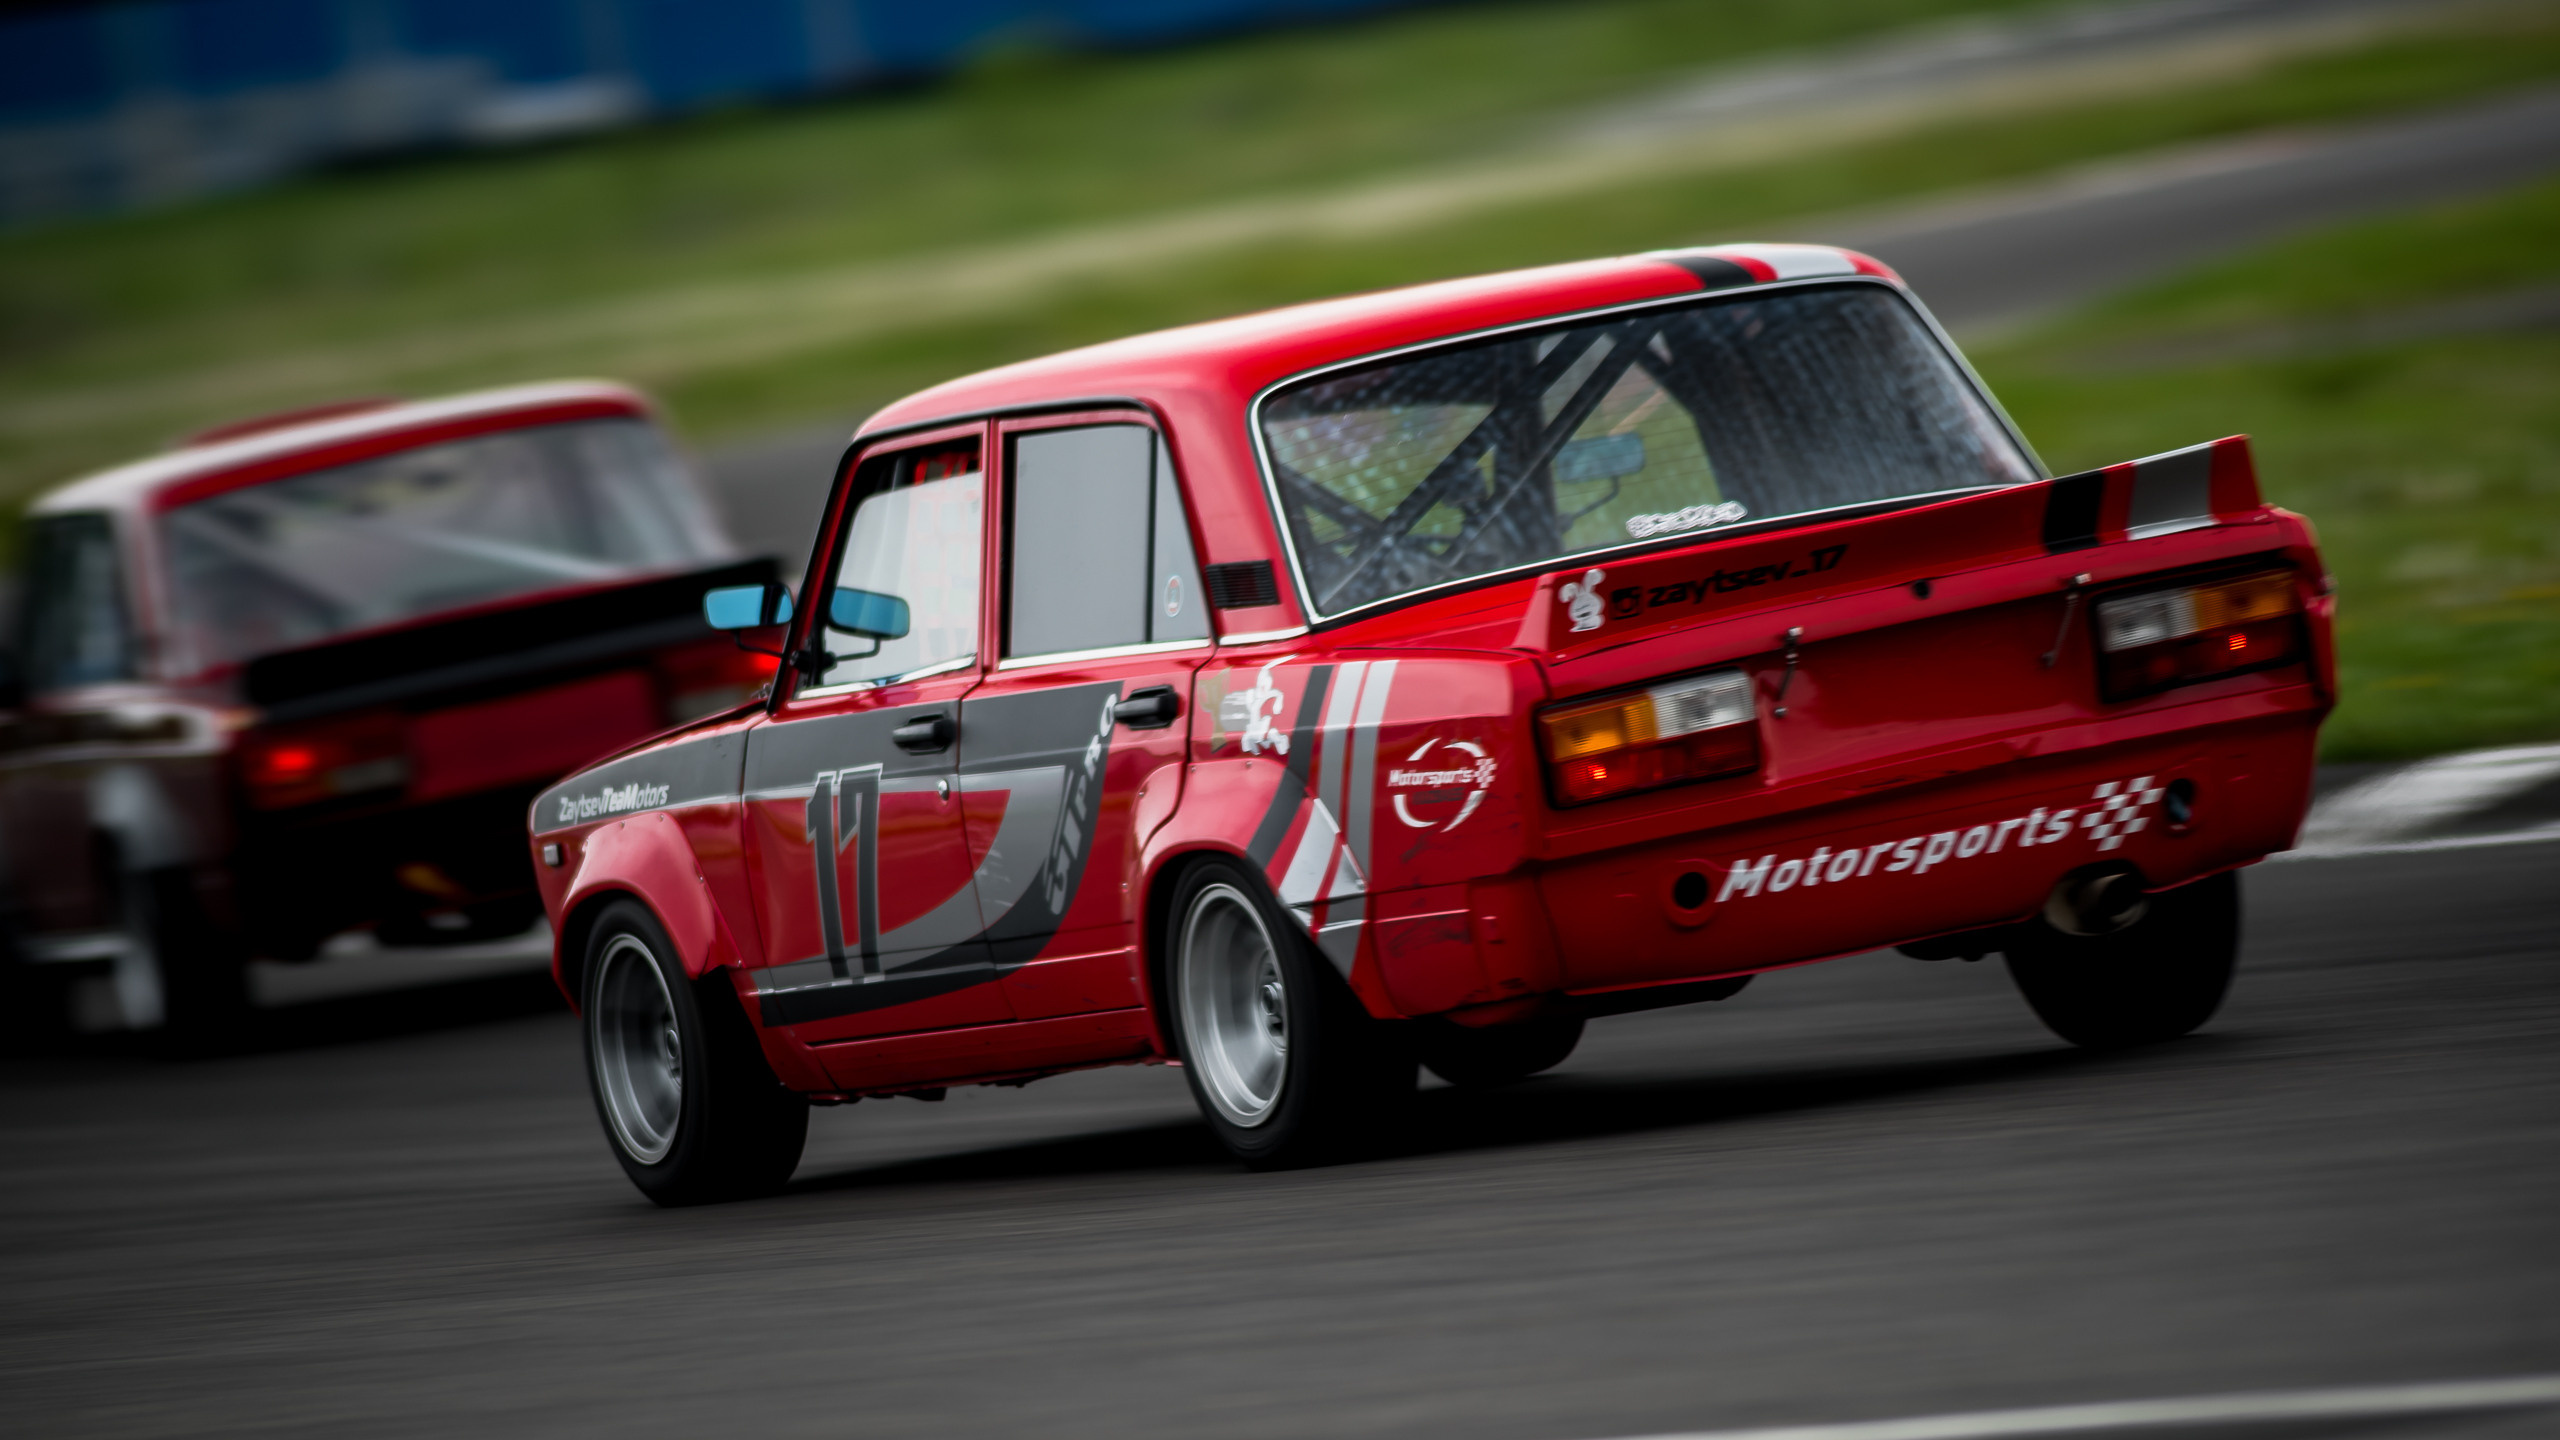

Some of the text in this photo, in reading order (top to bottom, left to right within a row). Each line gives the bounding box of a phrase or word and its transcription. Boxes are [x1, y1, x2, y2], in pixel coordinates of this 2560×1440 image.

[1647, 543, 1850, 608] zaytsev_17
[559, 782, 670, 825] ZaytsevTeaMotors
[1387, 766, 1474, 788] Motorsports
[806, 763, 884, 986] 17
[1714, 806, 2080, 903] Motorsports
